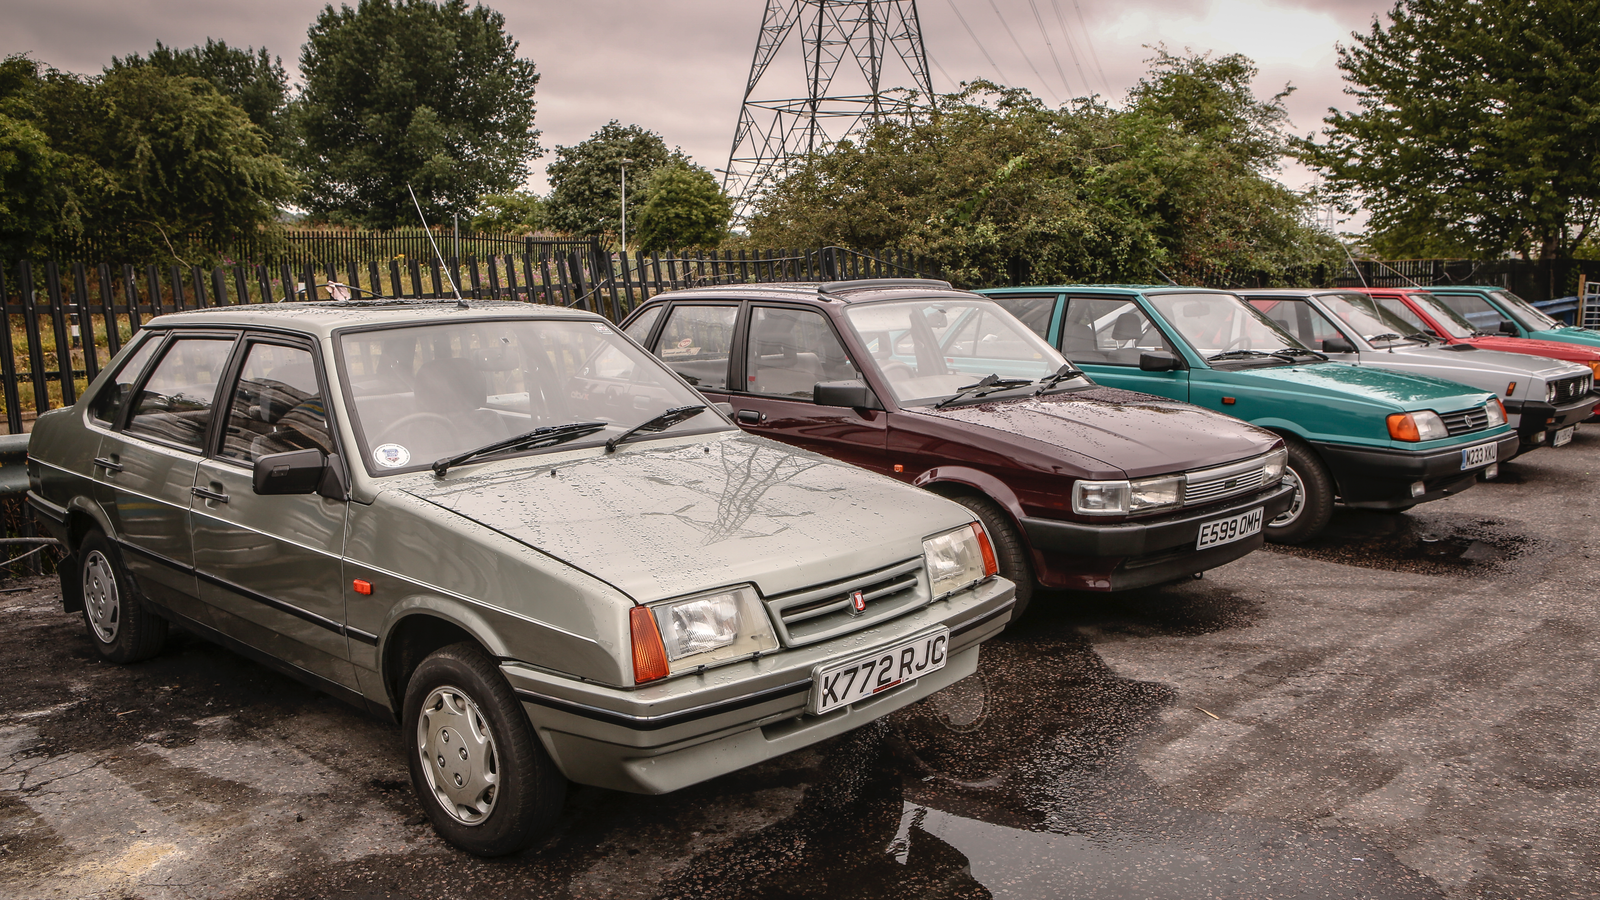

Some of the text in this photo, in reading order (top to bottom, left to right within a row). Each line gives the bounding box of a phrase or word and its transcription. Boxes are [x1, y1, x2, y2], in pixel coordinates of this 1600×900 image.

[1200, 510, 1262, 546] E599 OMH
[822, 635, 946, 708] K772 RJC
